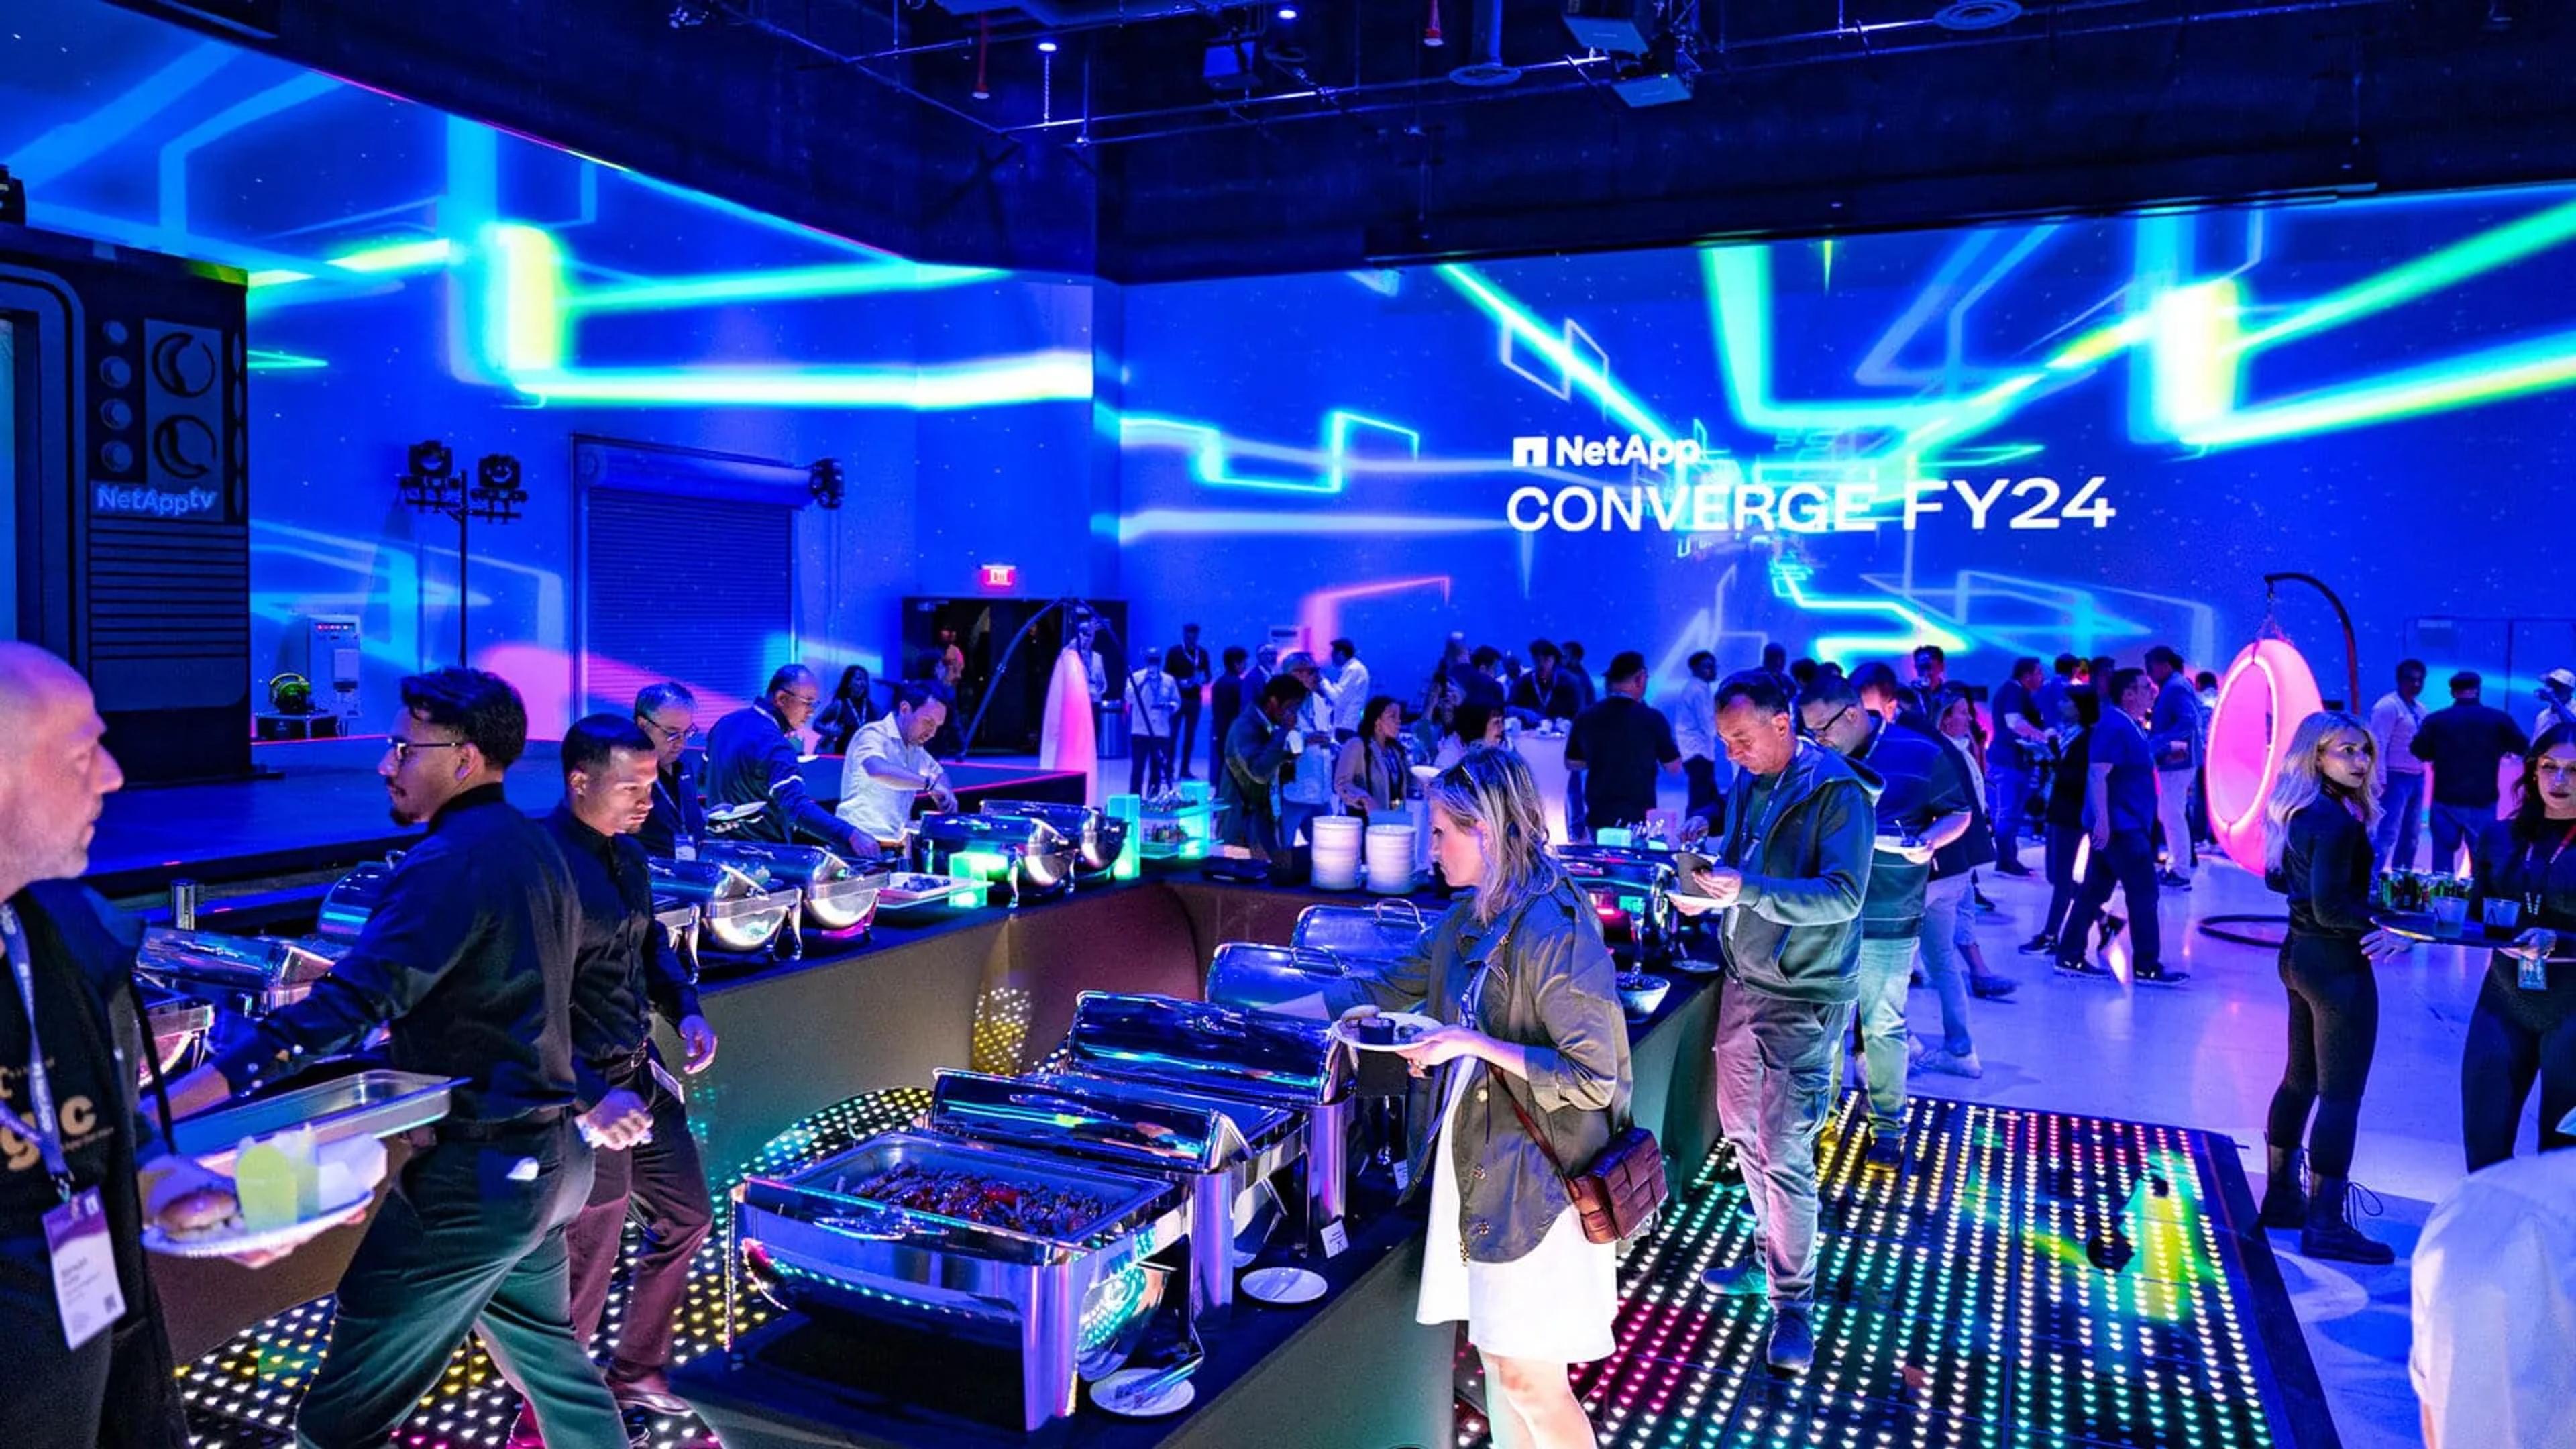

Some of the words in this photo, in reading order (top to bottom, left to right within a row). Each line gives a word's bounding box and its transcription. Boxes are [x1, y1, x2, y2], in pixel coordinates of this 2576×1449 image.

[1556, 434, 1701, 471] NetApp
[1506, 484, 1878, 533] CONVERGE
[1902, 476, 2117, 531] FY24
